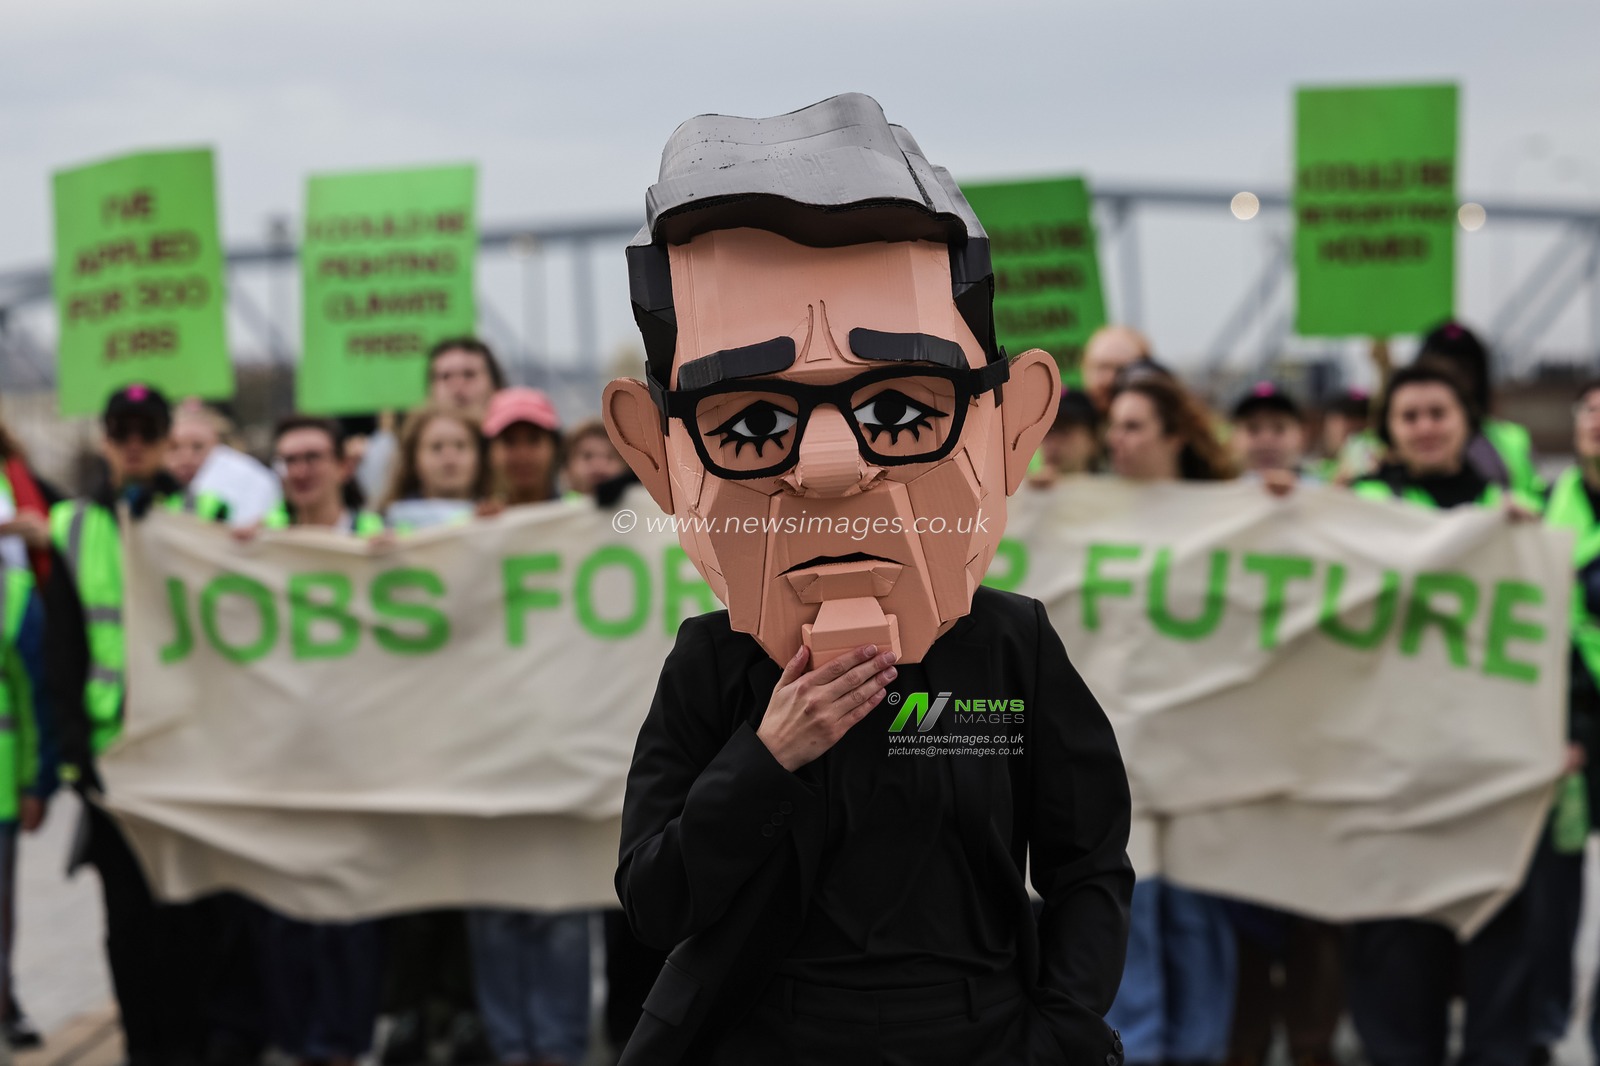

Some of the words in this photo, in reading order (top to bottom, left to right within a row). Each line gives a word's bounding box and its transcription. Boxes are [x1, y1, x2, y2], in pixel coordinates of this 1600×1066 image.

[158, 567, 451, 665] JOBS
[503, 544, 718, 646] FOR
[1080, 541, 1547, 684] FUTURE
